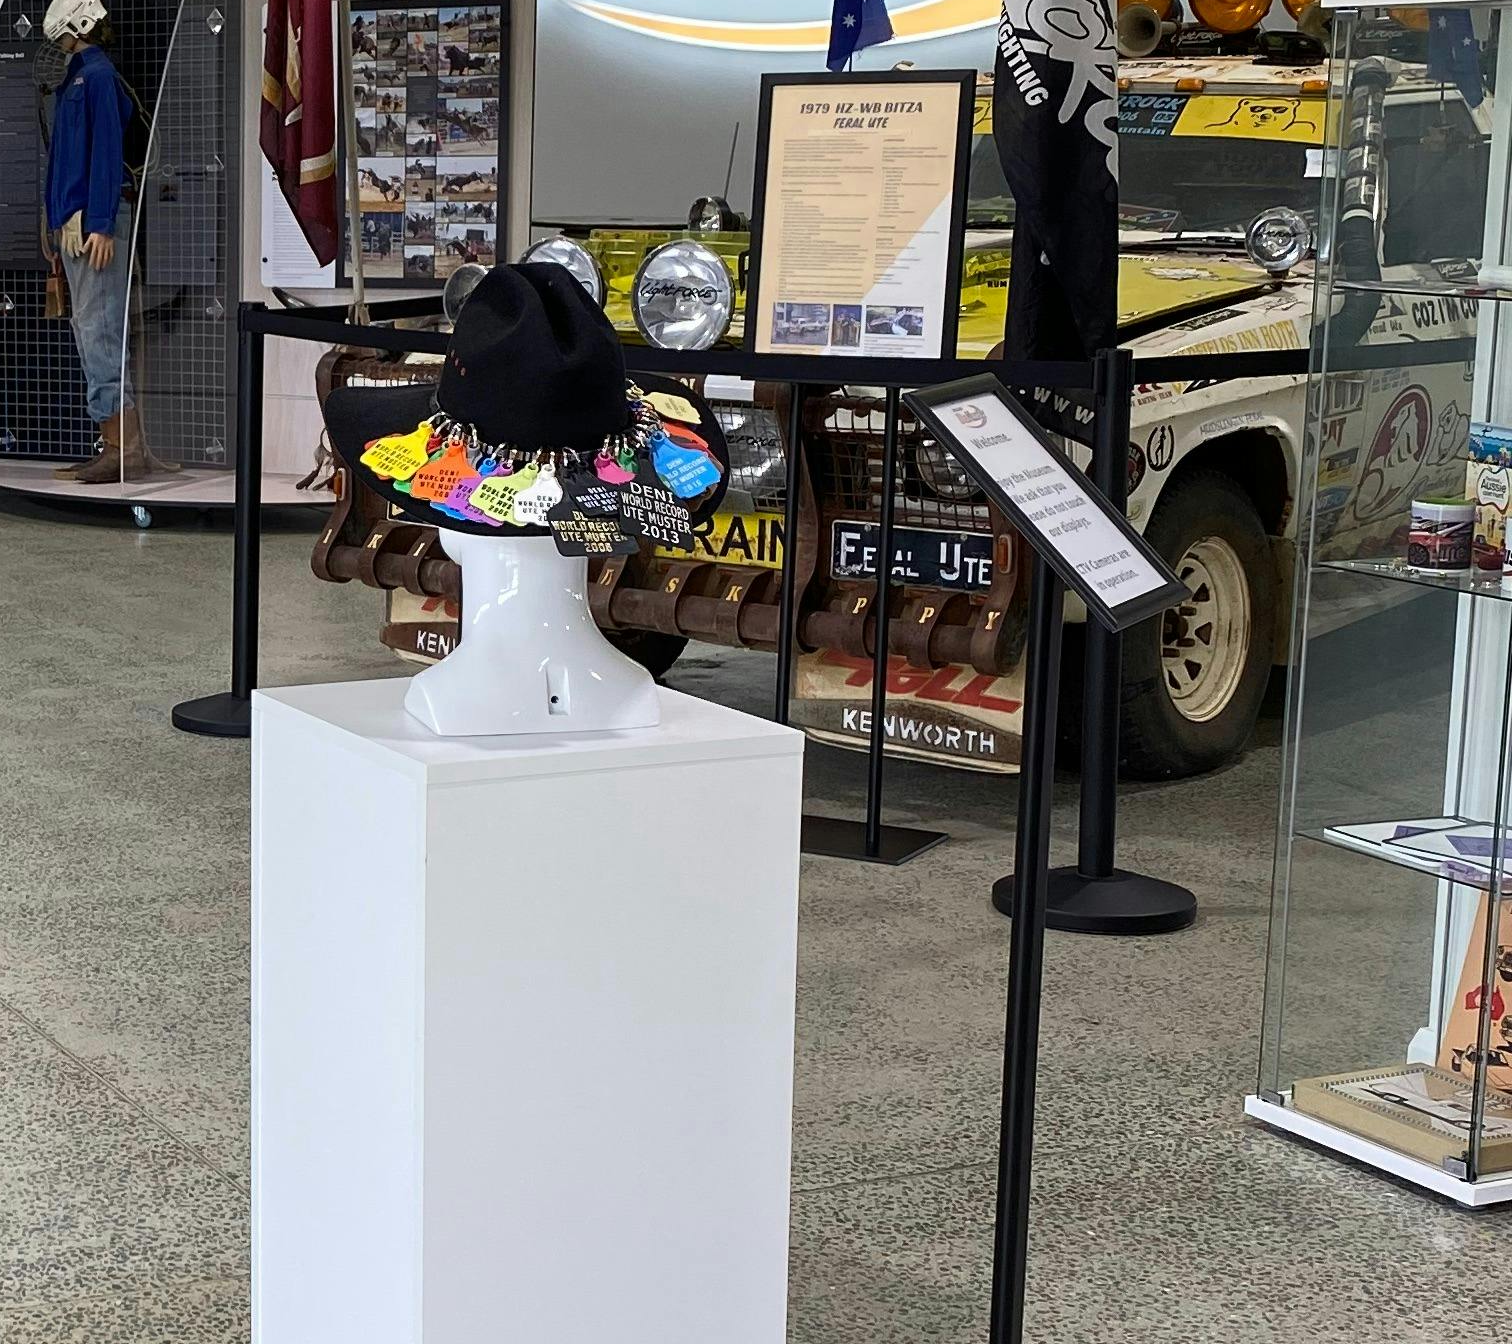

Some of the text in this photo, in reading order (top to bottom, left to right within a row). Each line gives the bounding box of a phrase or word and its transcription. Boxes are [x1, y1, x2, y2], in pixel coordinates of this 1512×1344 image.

[800, 102, 830, 114] 1979
[884, 100, 923, 114] BITZA
[833, 116, 890, 129] FERAL UTE
[630, 481, 675, 504] DENI
[620, 491, 690, 522] WORLD RECORD
[551, 520, 588, 531] WORLD
[623, 505, 693, 535] UTE MUSTER
[560, 531, 583, 542] UTE
[639, 522, 681, 545] 2013
[840, 531, 920, 578] FEAL
[416, 629, 457, 656] KEN
